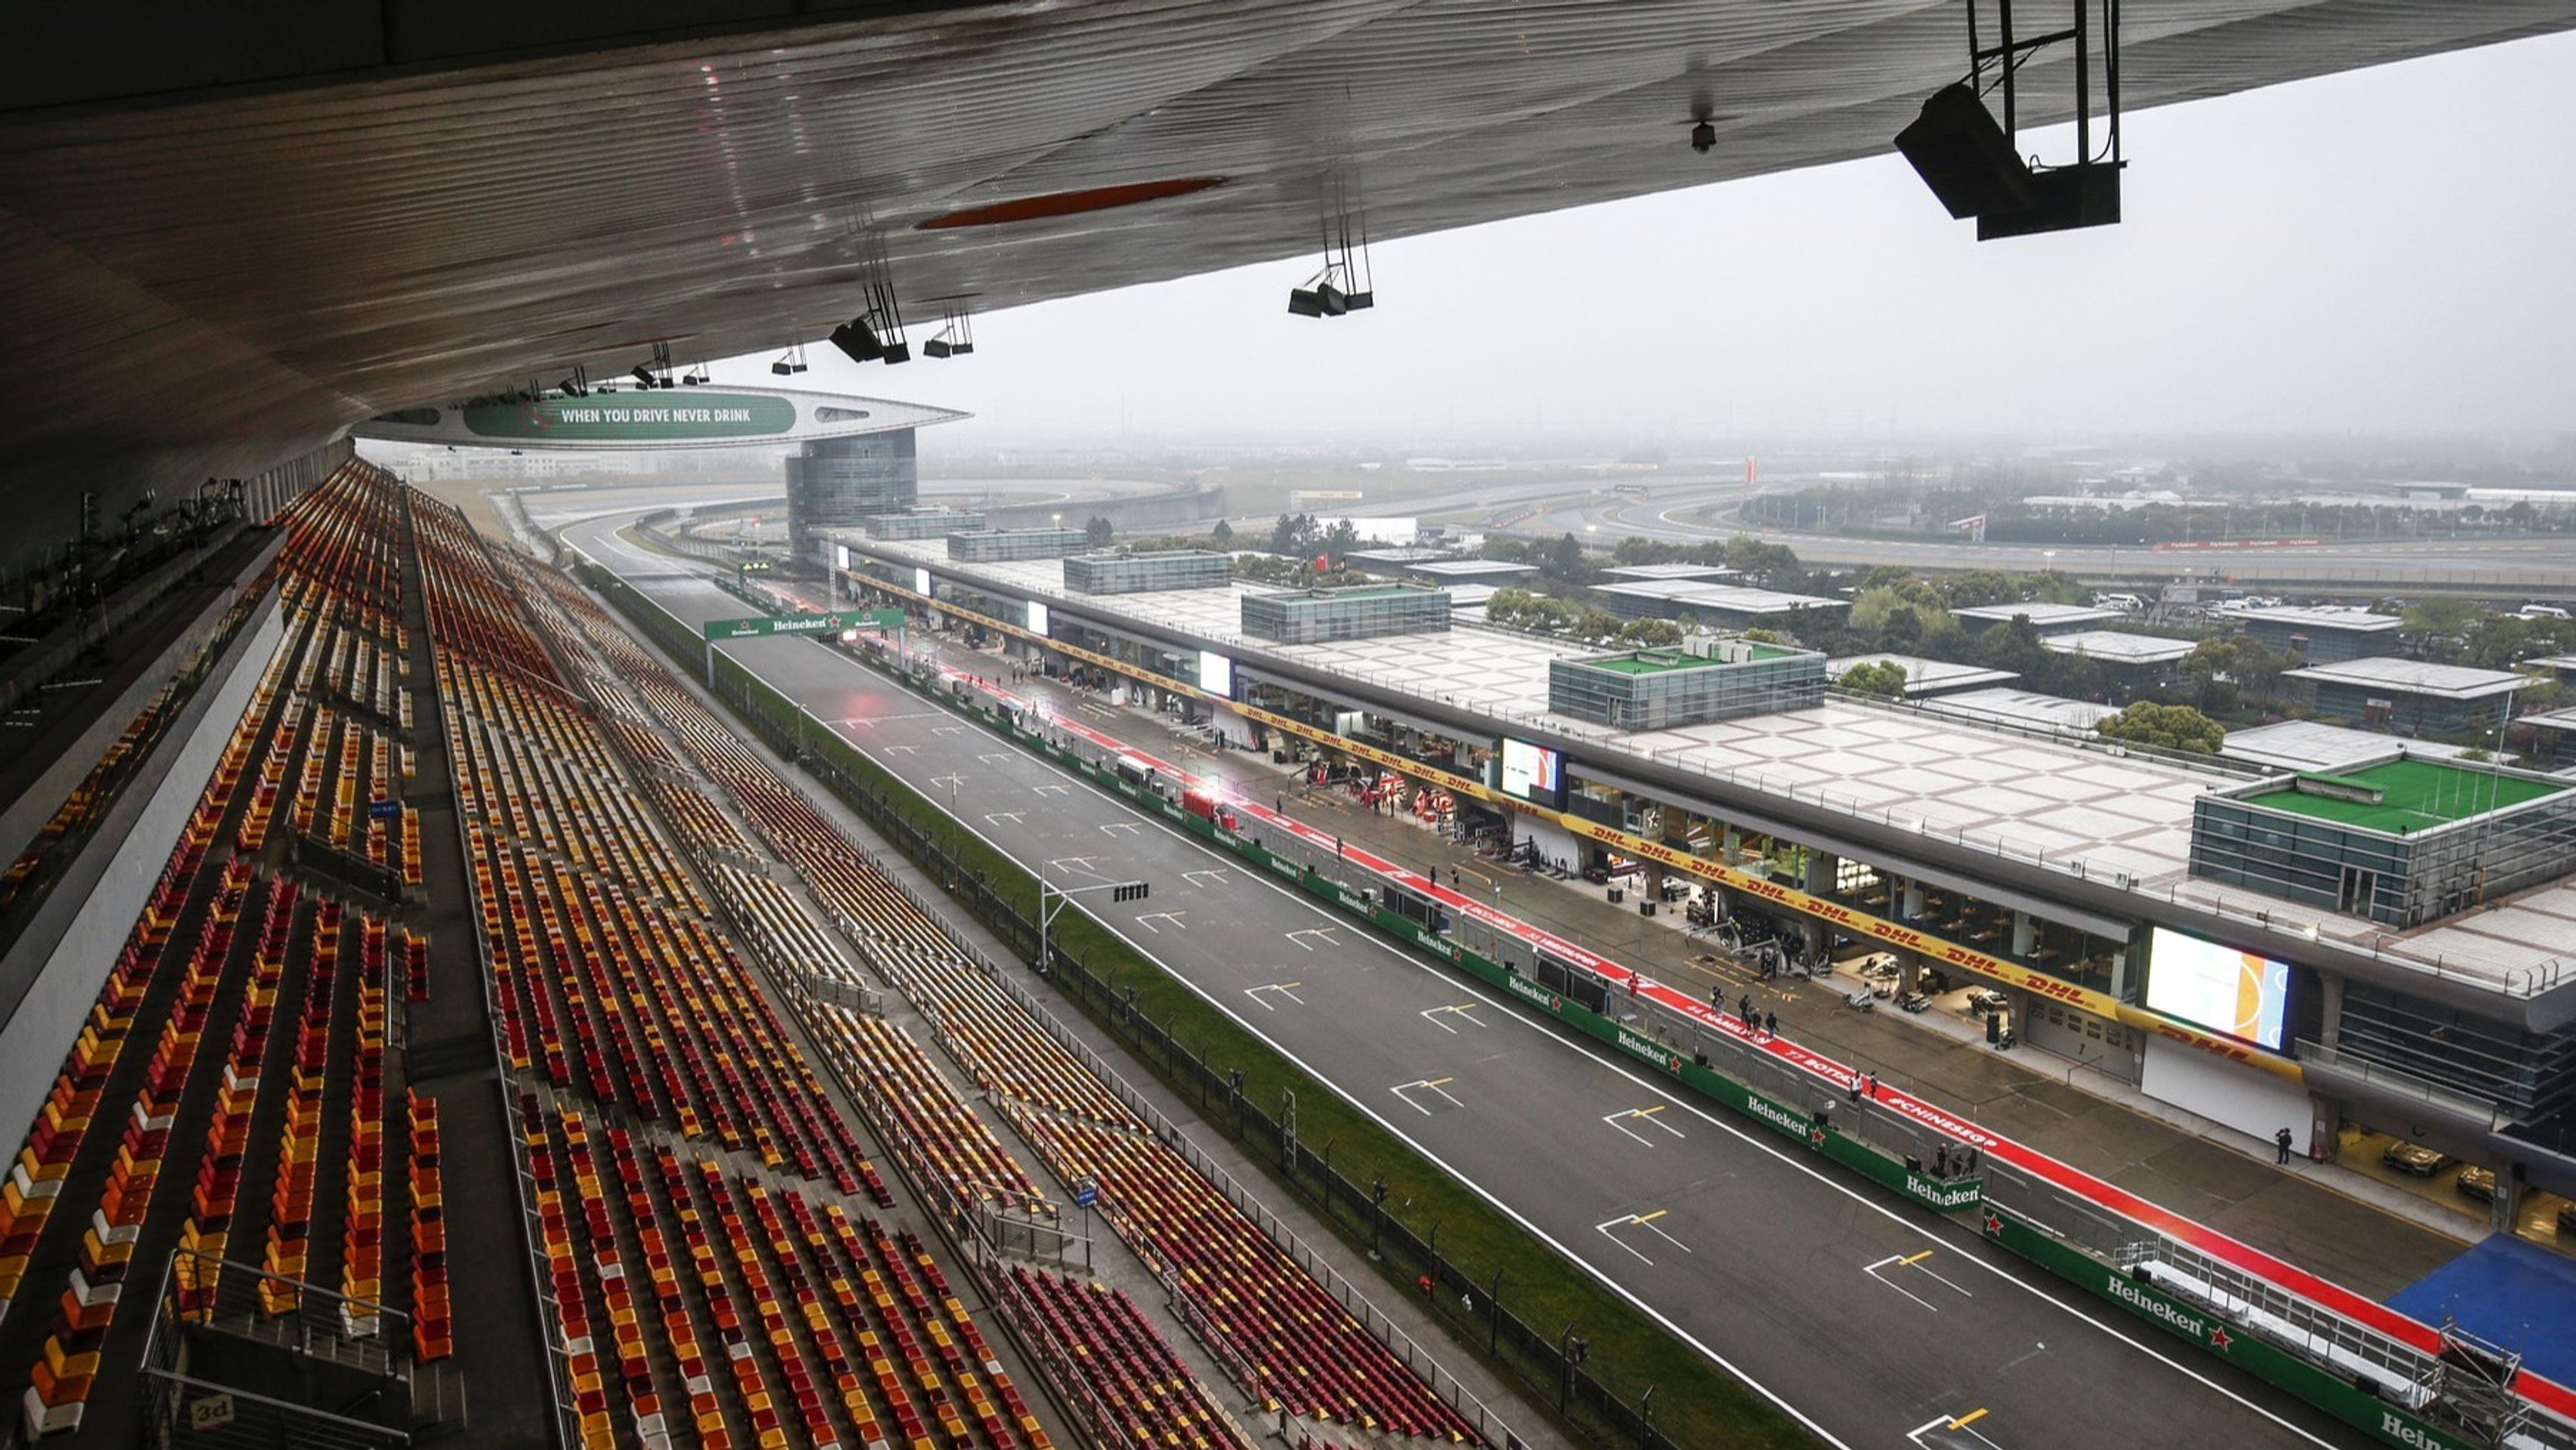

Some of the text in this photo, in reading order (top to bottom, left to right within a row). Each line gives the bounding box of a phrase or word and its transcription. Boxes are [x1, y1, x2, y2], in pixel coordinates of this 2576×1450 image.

[561, 409, 750, 423] WHEN YOU DRIVE NEVER DRINK
[774, 616, 827, 631] Heineken
[1323, 733, 1343, 747] DHL
[1351, 743, 1372, 757] DHL
[1381, 754, 1403, 769] DHL
[1413, 765, 1437, 780] DHL
[1446, 776, 1472, 792] DHL
[1594, 826, 1625, 847] DHL
[1640, 842, 1674, 862] DHL
[1691, 859, 1728, 881] DHL
[1339, 890, 1369, 914] Heineken
[1747, 879, 1787, 902] DHL
[1807, 899, 1851, 924] DHL
[1417, 929, 1453, 957] Heineken
[1873, 922, 1922, 949] DHL
[1946, 947, 2001, 974] DHL
[1509, 976, 1549, 1007] Heineken
[2026, 974, 2085, 1004] DHL
[1618, 1030, 1668, 1066] Heineken
[1803, 1059, 1852, 1083] BOTTA
[1747, 1096, 1808, 1137] Heineken
[1887, 1097, 1998, 1147] #CHINESEGP
[1906, 1174, 1981, 1206] Heineken
[2107, 1275, 2205, 1337] Heineken
[2381, 1411, 2454, 1449] Hein
